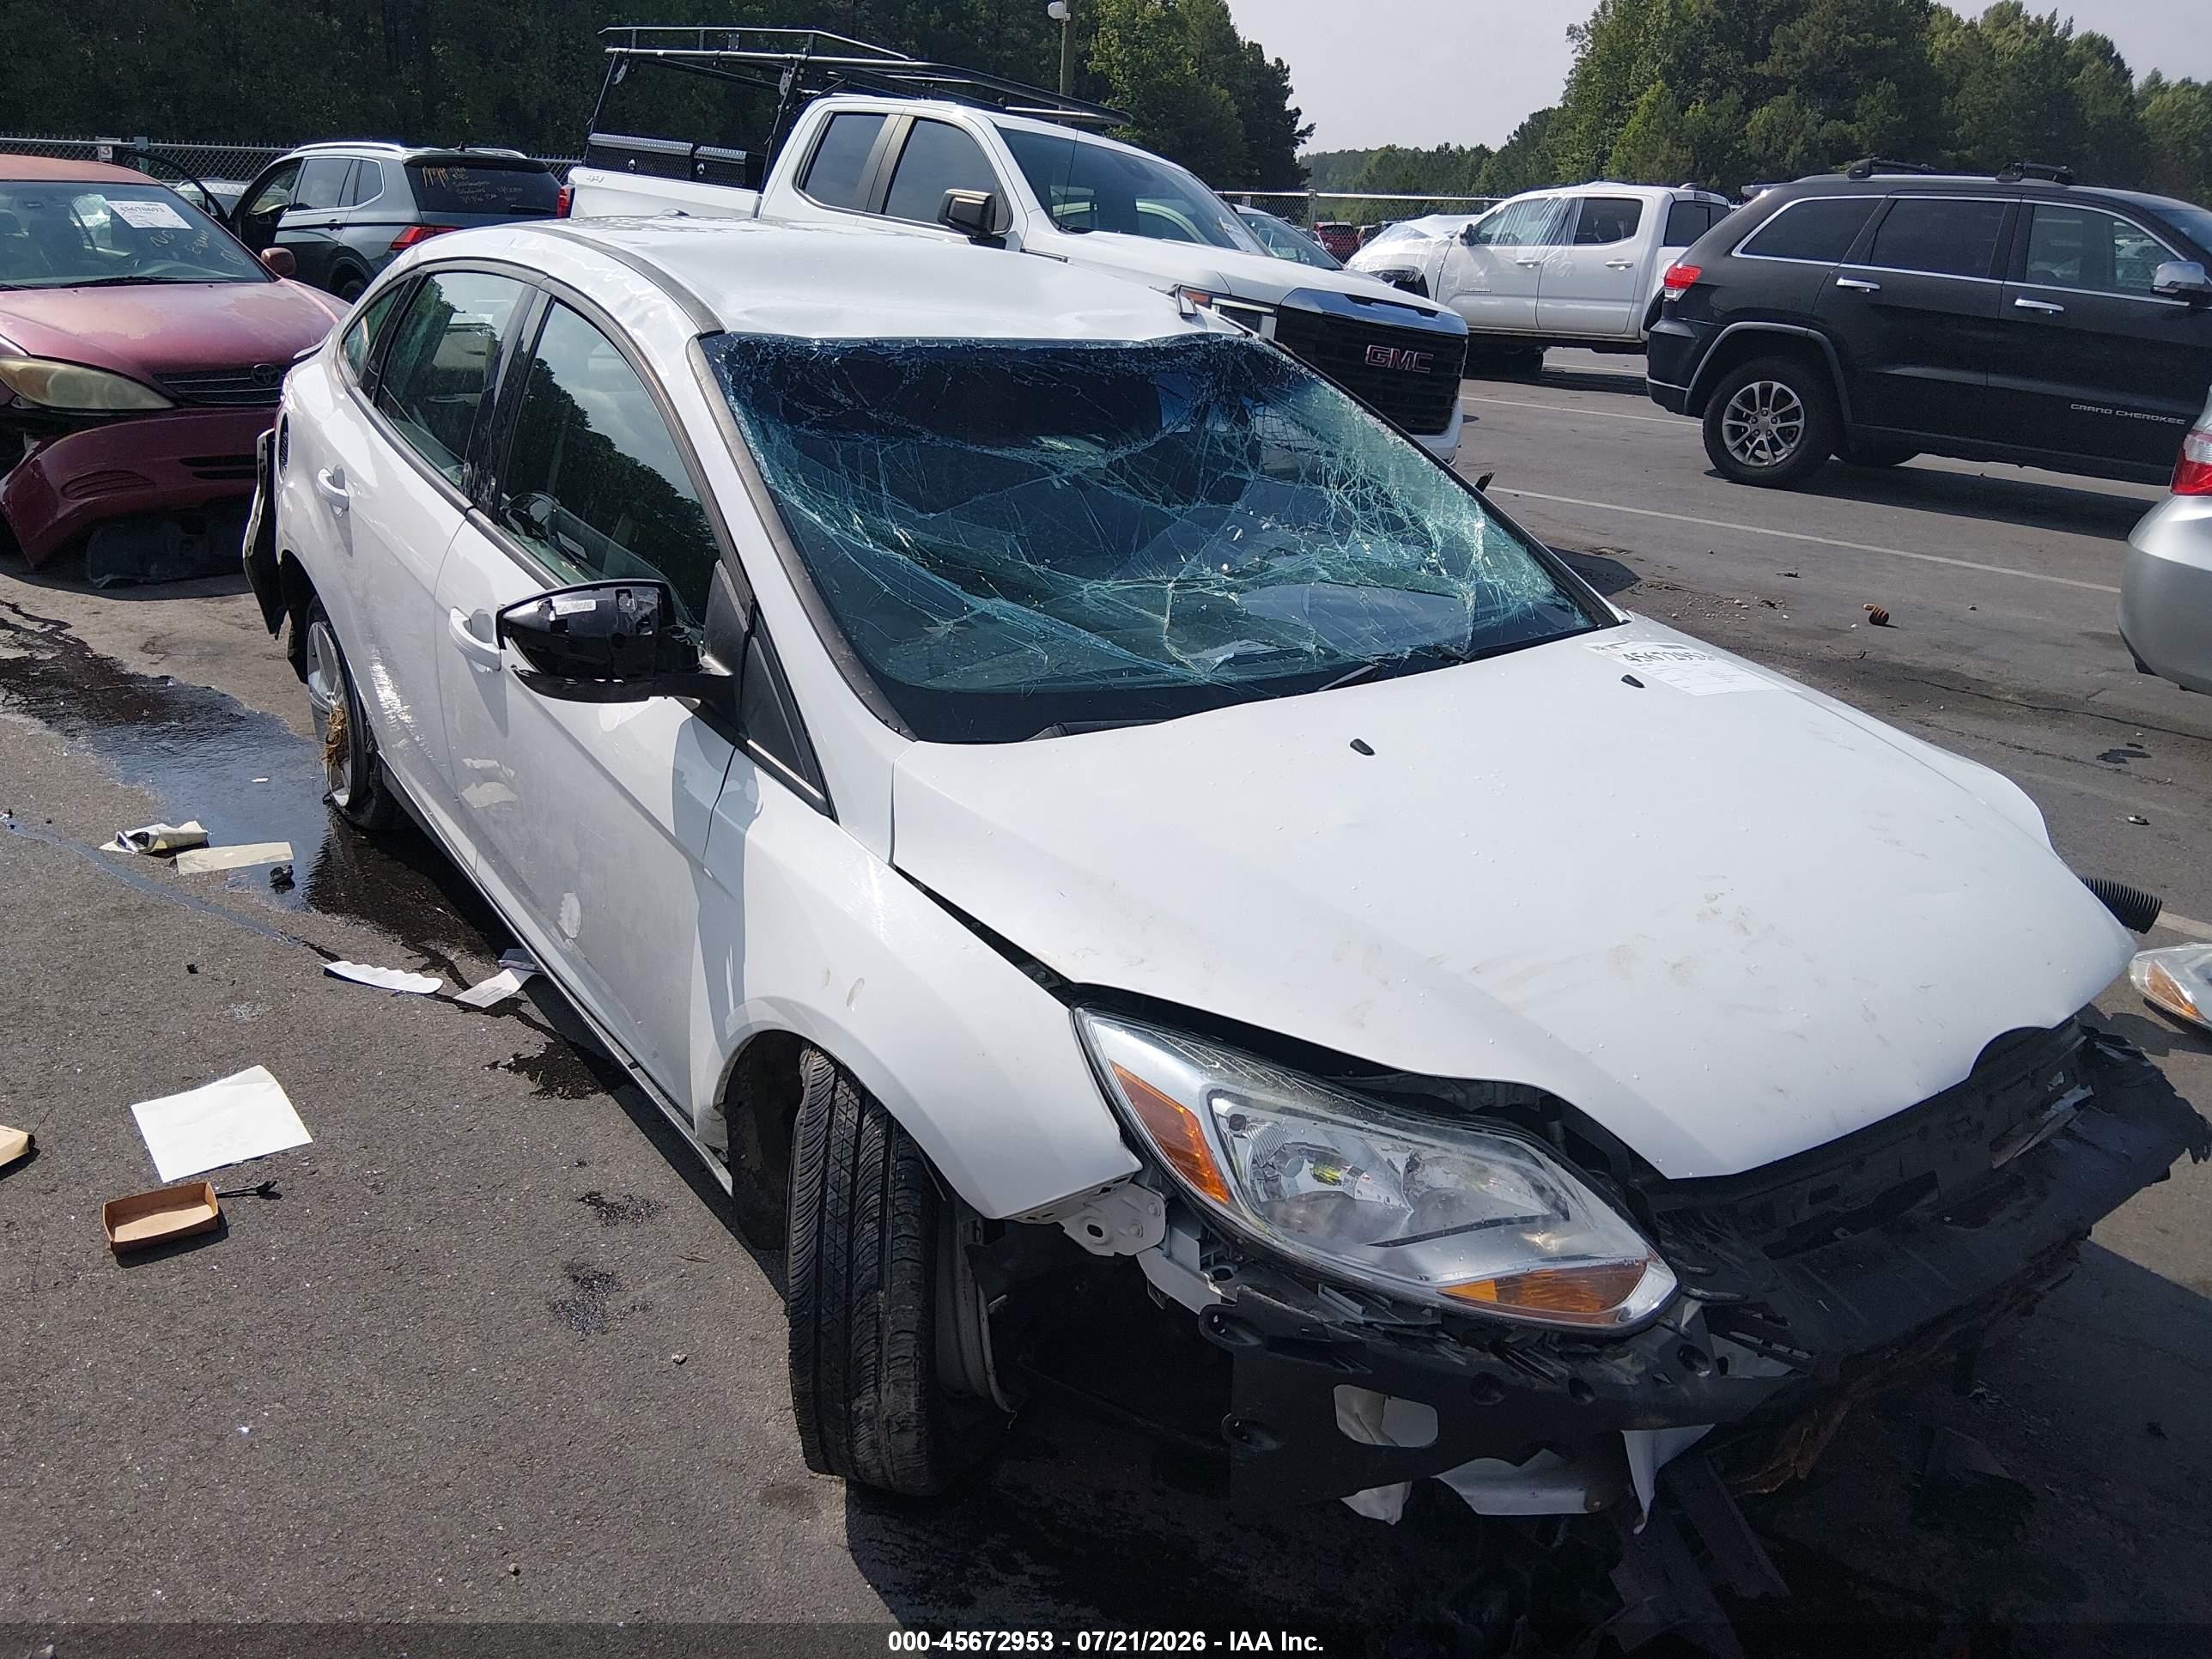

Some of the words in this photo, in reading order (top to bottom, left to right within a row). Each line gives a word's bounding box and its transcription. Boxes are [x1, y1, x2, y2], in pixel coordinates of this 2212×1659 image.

[1364, 344, 1434, 374] GMC
[2070, 404, 2112, 415] GRAND
[2115, 410, 2185, 425] CHEROKEE
